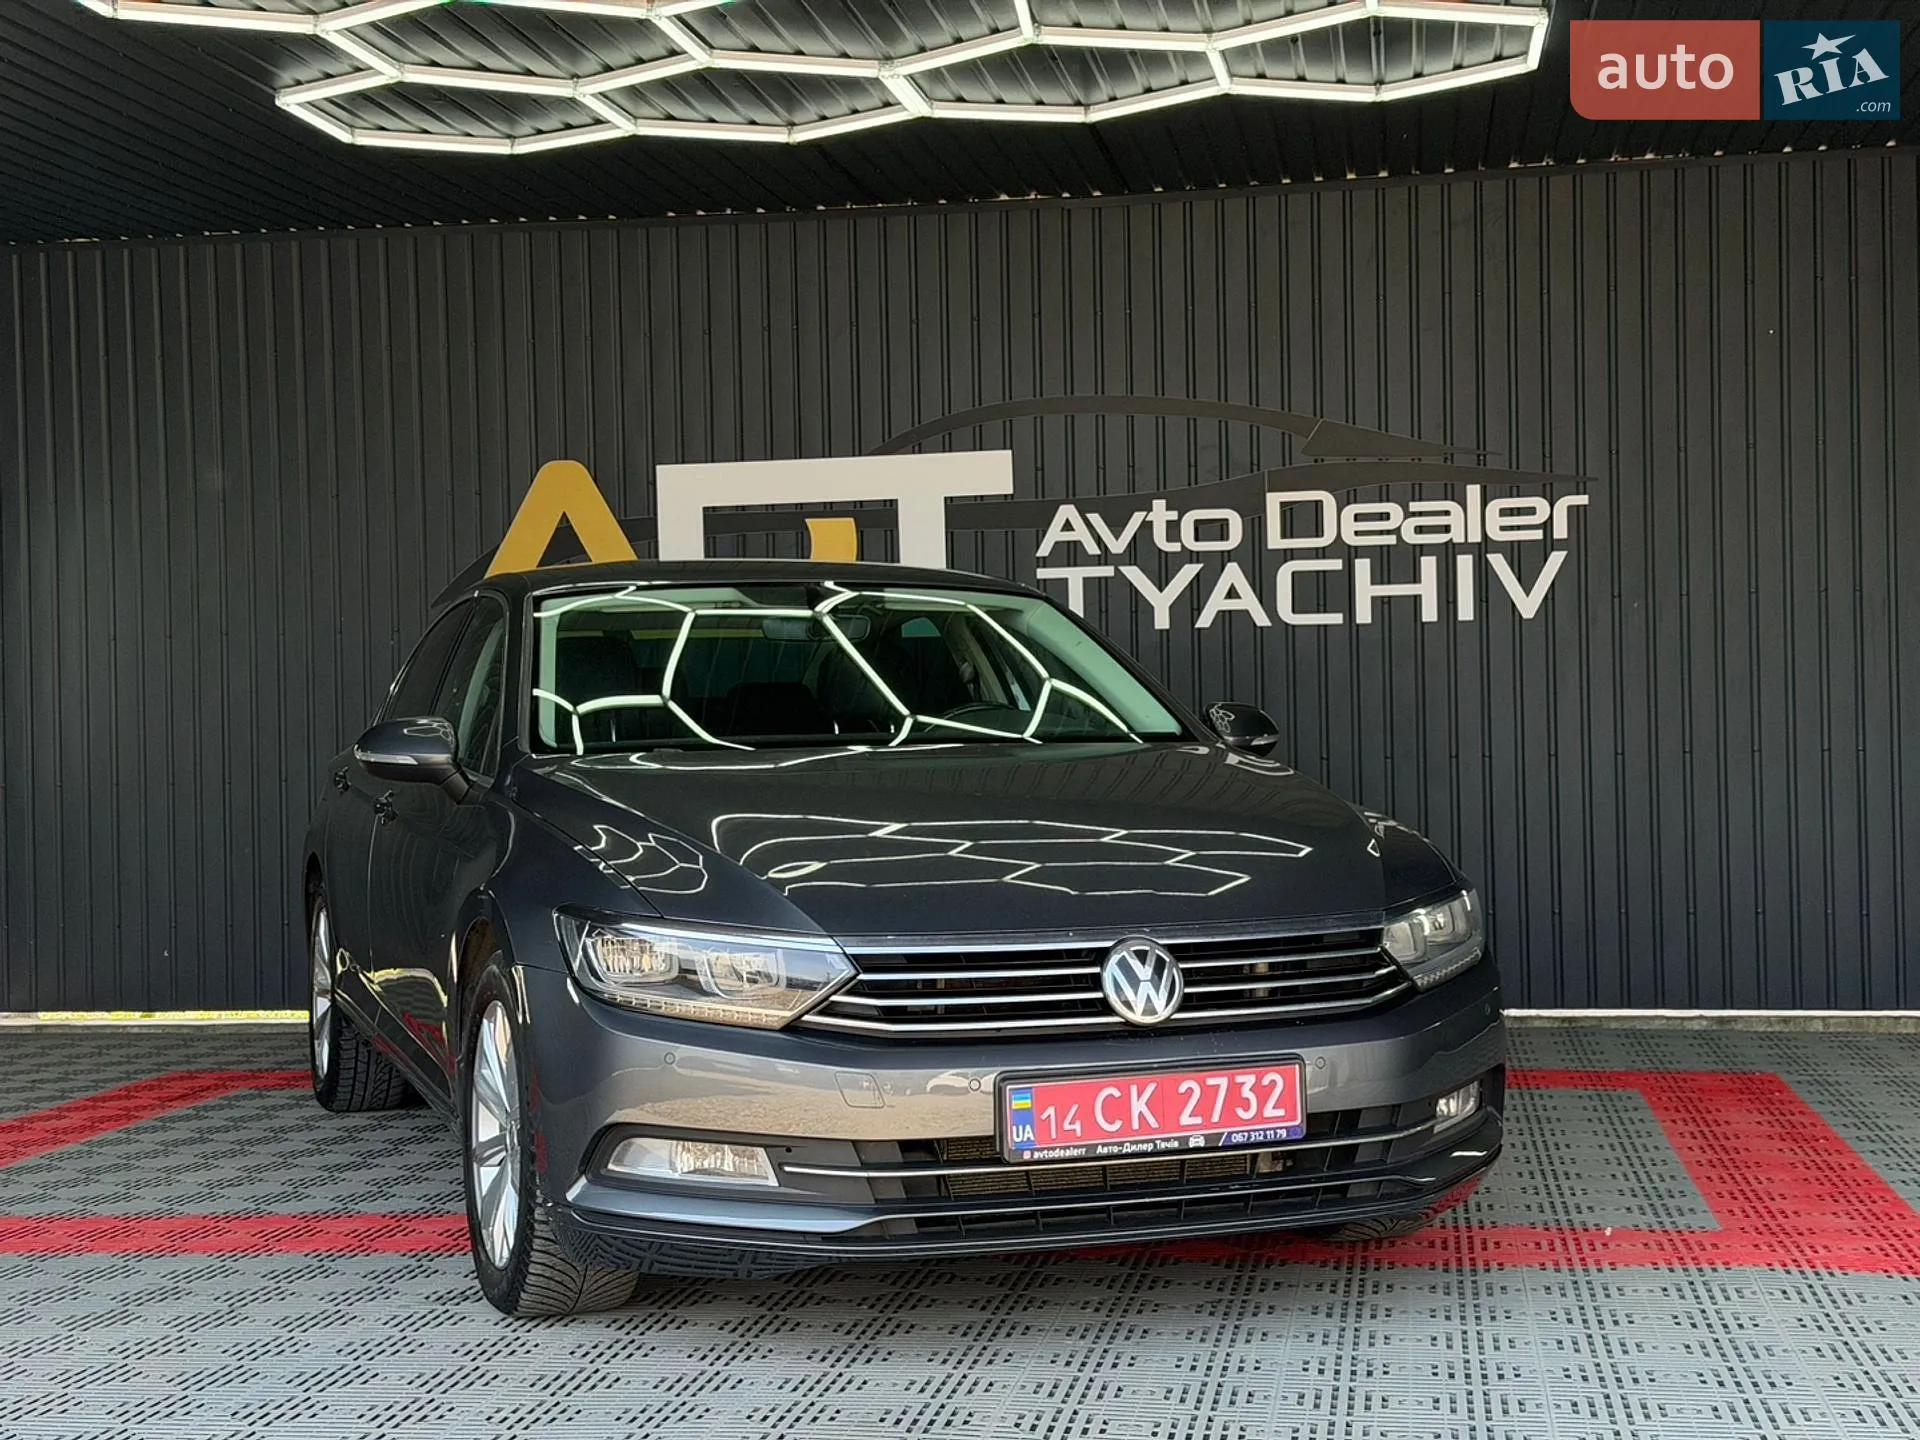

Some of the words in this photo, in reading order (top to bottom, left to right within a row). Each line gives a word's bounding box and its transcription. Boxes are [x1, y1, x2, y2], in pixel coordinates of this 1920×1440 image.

[1036, 498, 1244, 557] Avto
[1266, 484, 1590, 550] Dealer
[1036, 550, 1569, 630] TYACHIV
[1040, 1105, 1082, 1140] 14
[1093, 1082, 1161, 1132] CK
[1177, 1071, 1286, 1126] 2732
[1012, 1124, 1035, 1143] UA
[1096, 1142, 1154, 1154] Авто-Дилер
[1249, 1130, 1264, 1142] 312
[1266, 1129, 1275, 1140] 11
[1275, 1128, 1287, 1139] 79
